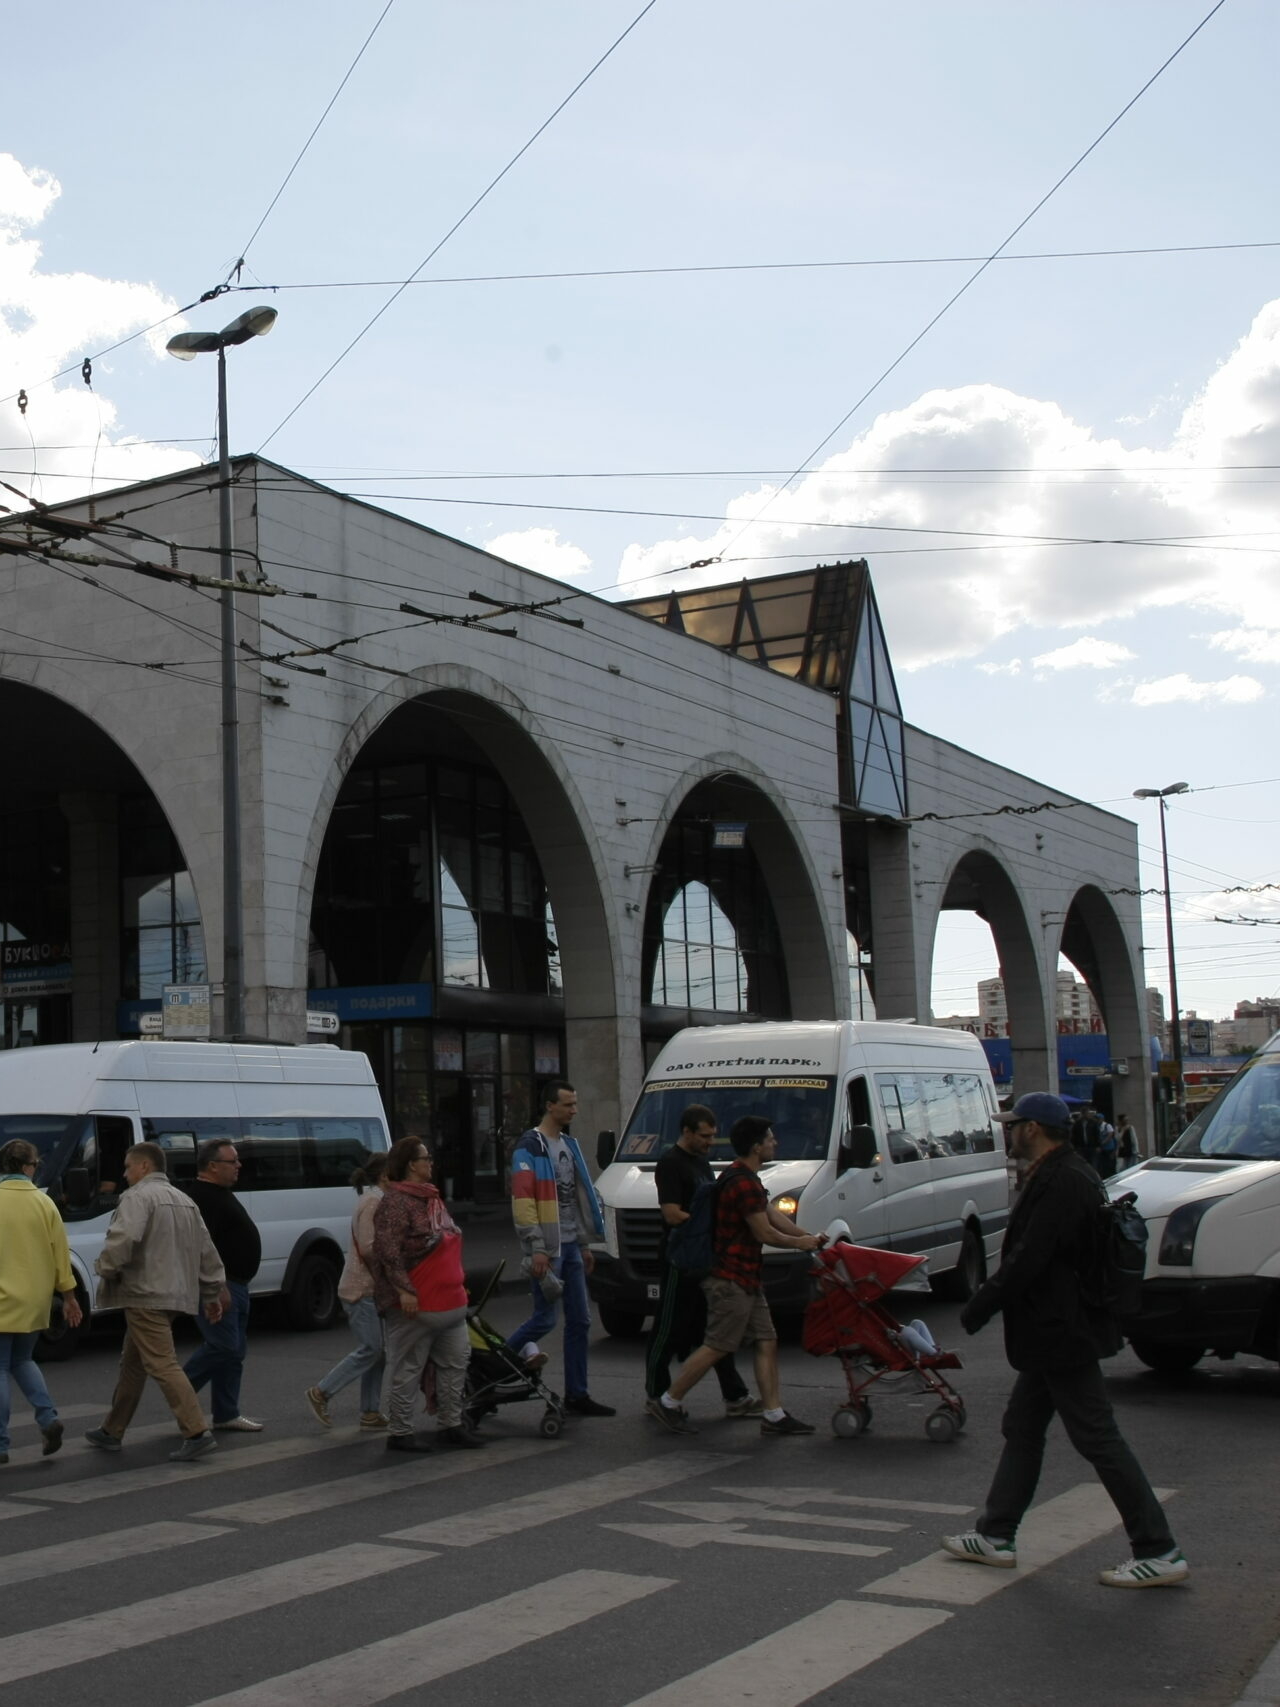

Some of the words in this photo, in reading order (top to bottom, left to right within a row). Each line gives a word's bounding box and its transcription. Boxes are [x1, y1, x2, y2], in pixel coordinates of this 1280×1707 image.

[350, 995, 416, 1010] подарки
[666, 1062, 694, 1072] ОАО
[769, 1057, 822, 1067] ПАРК»
